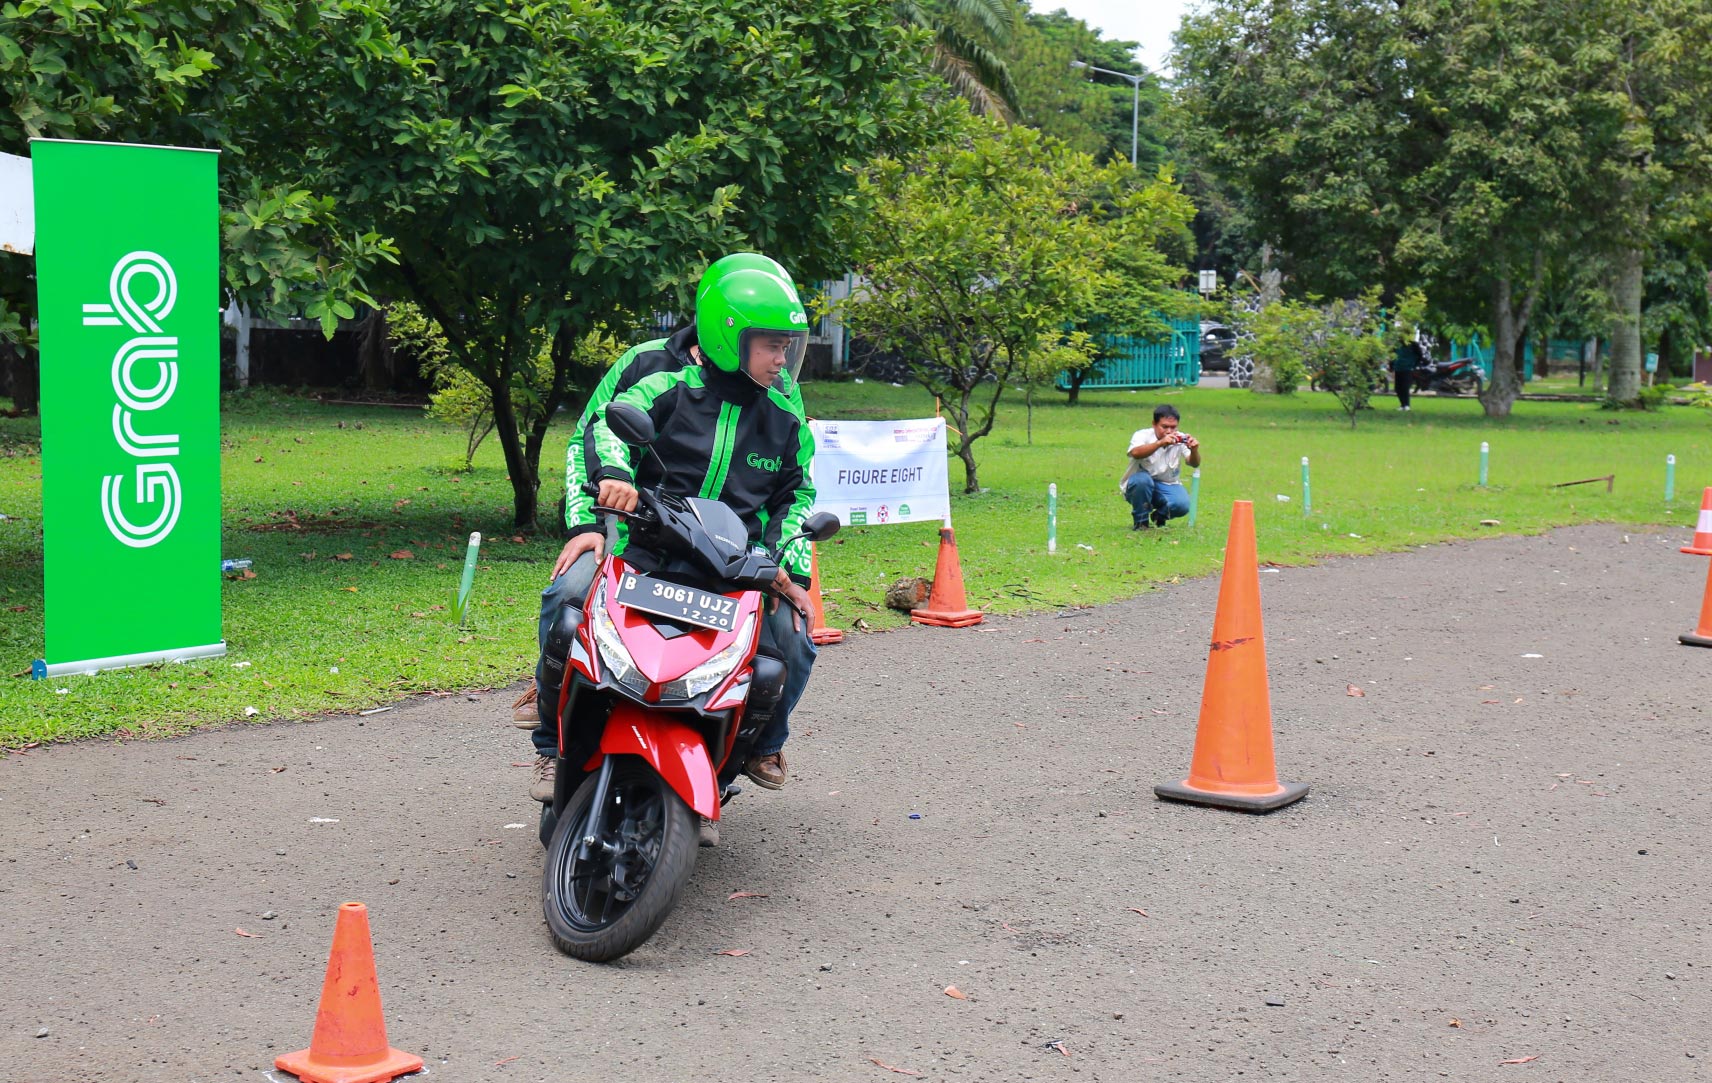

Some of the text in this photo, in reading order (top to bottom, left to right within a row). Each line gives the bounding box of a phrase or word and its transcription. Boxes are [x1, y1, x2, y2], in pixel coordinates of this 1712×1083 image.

[82, 250, 182, 548] Grab
[566, 443, 584, 528] GrabBike
[838, 466, 923, 485] FIGURE EIGHT
[624, 576, 734, 615] B 3061 UJZ
